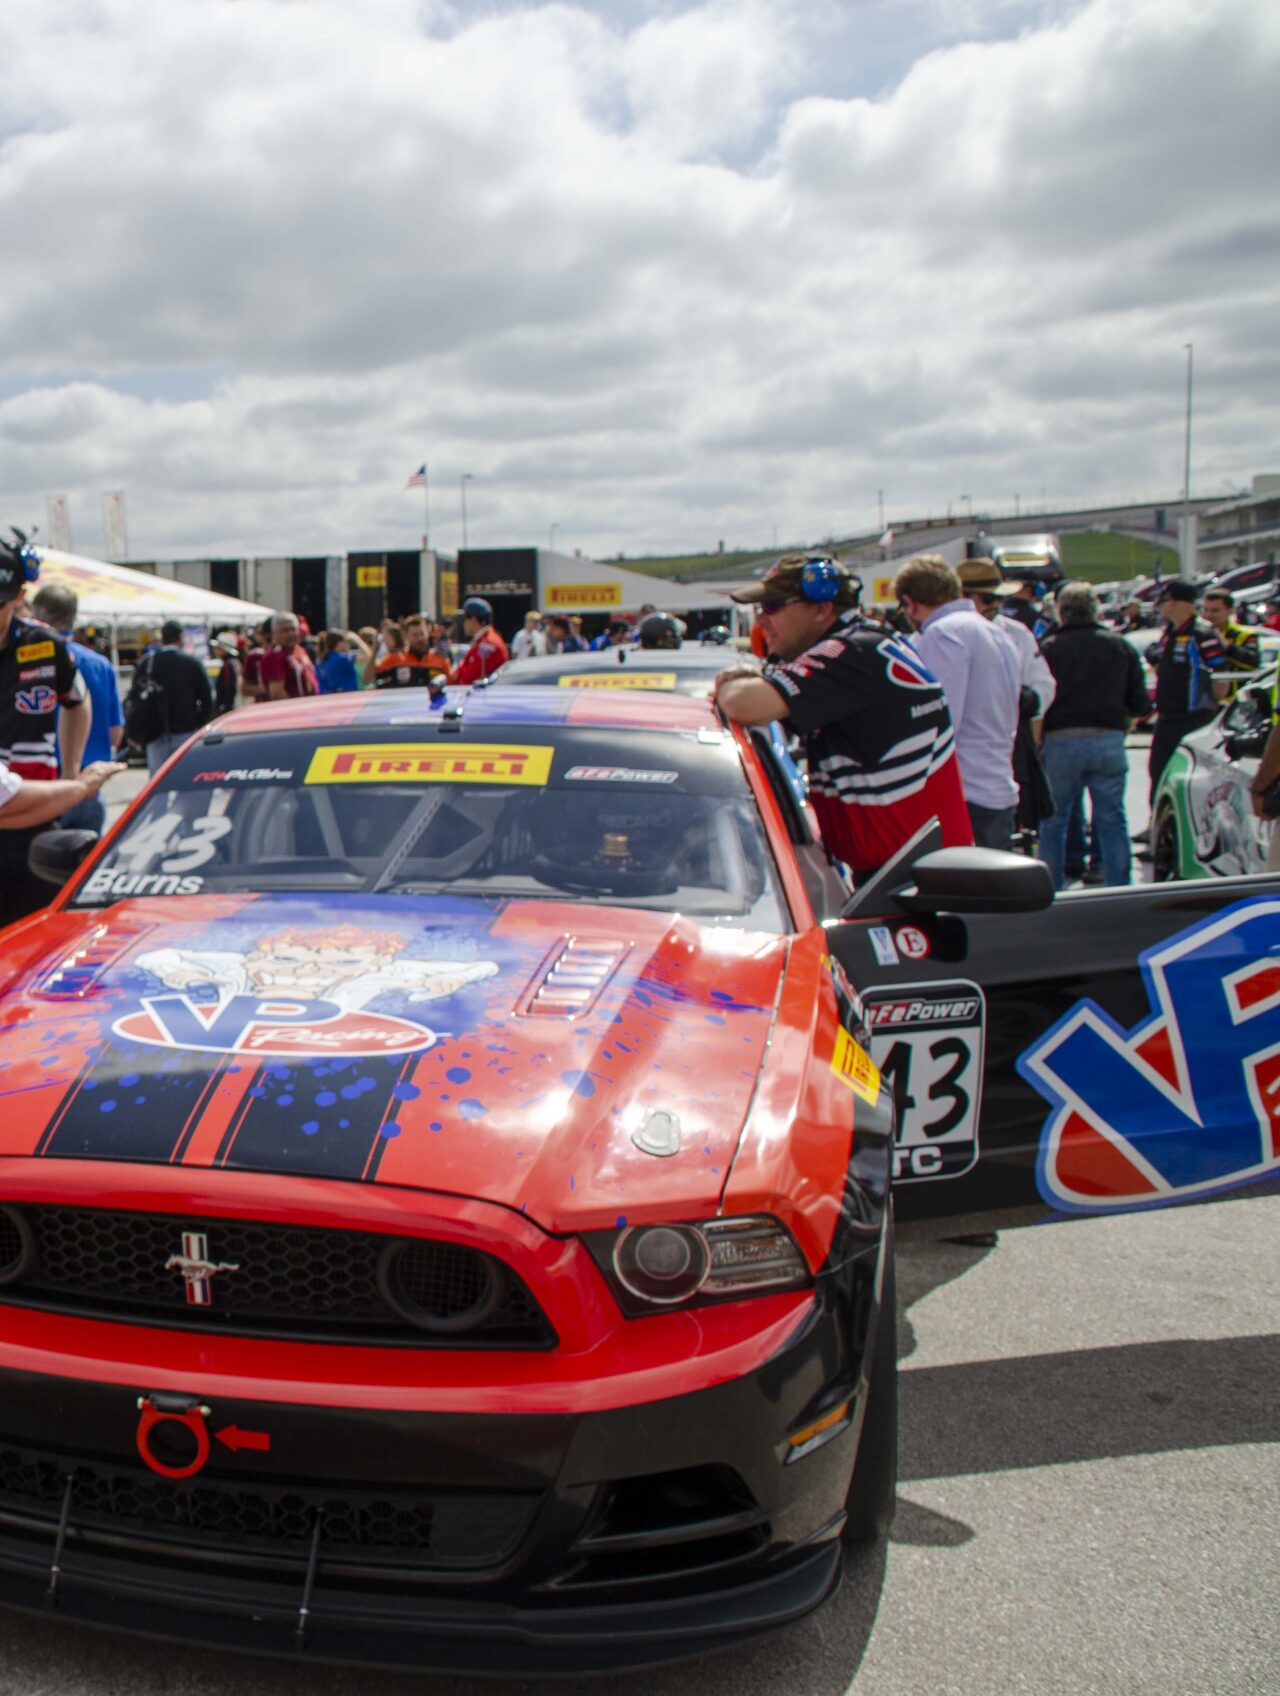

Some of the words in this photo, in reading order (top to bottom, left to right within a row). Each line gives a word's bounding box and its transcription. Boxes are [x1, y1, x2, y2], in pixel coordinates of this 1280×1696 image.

[550, 586, 616, 604] PIRELLI
[330, 752, 529, 775] PIRELLI
[118, 811, 233, 875] 43
[82, 867, 205, 896] Burns
[139, 994, 348, 1050] VP
[880, 1036, 972, 1144] 43
